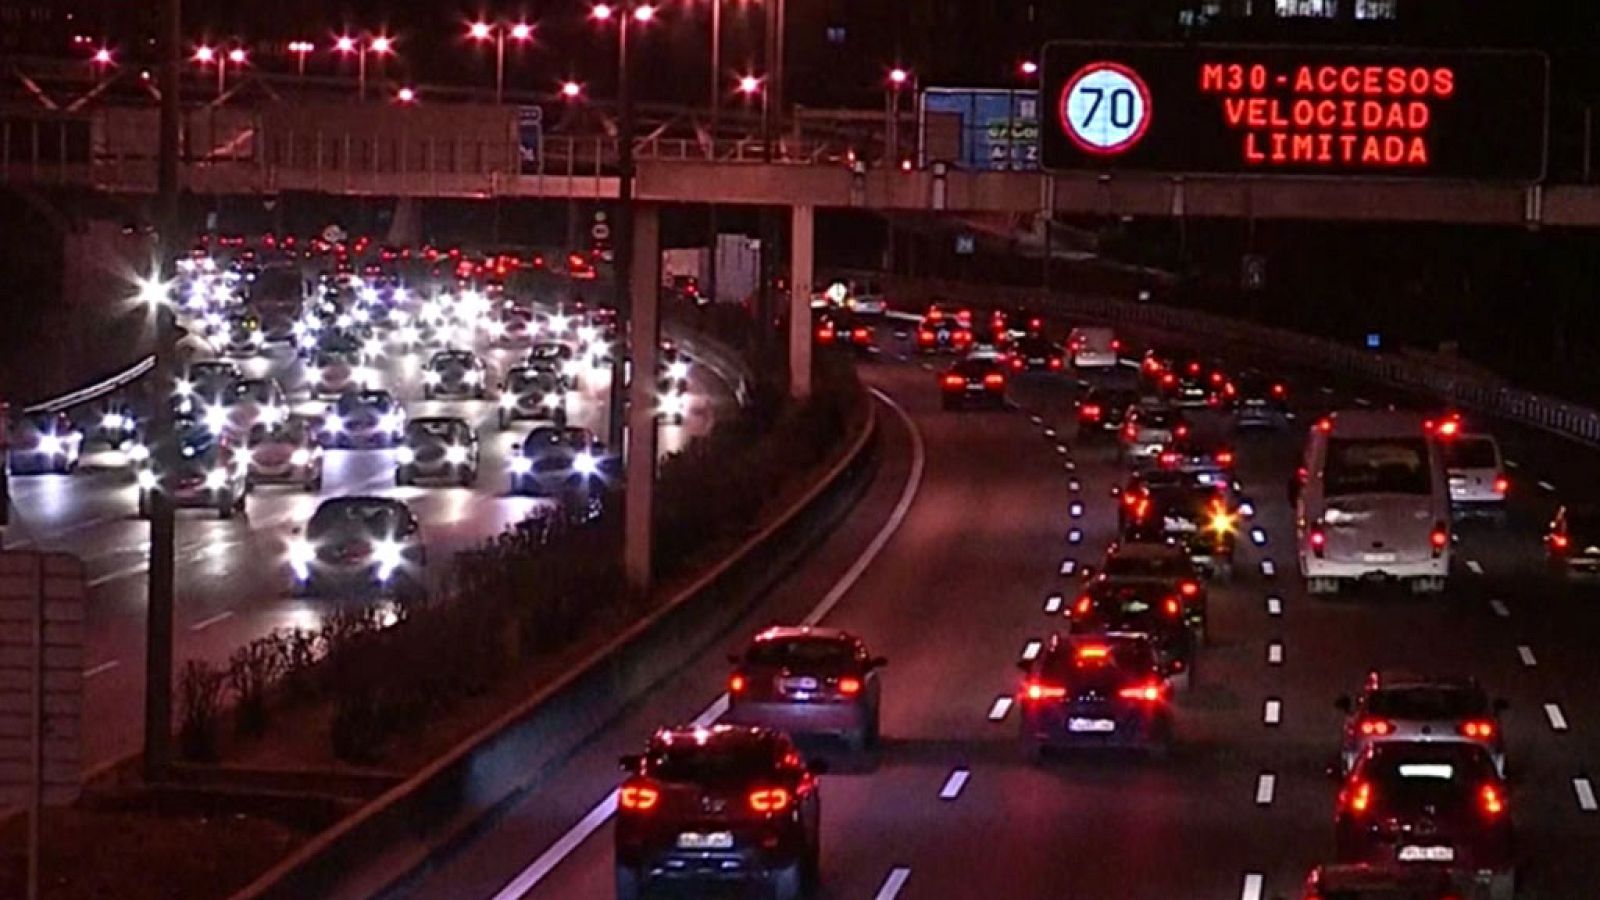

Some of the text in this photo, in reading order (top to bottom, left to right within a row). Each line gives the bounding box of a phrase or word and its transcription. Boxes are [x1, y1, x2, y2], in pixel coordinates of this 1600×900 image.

[1079, 87, 1136, 130] 70
[1224, 97, 1429, 130] VELOCIDAD
[1245, 131, 1427, 165] LIMITADA
